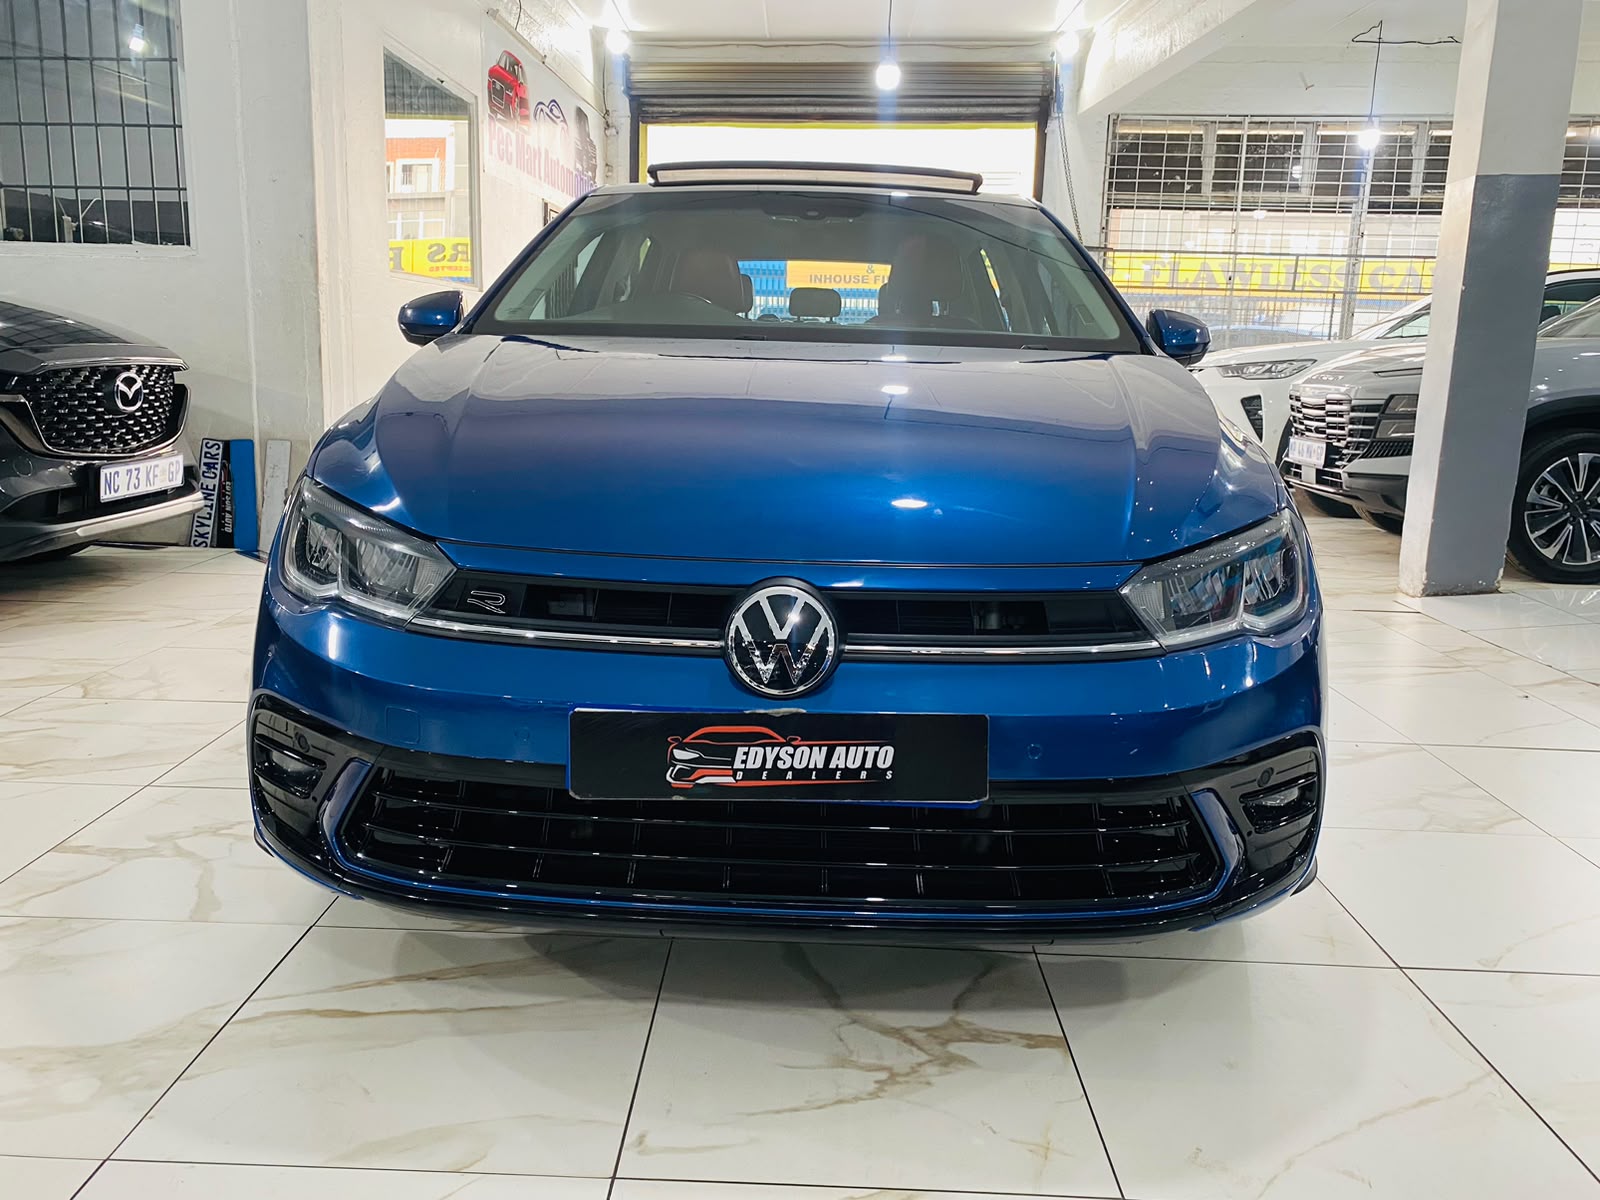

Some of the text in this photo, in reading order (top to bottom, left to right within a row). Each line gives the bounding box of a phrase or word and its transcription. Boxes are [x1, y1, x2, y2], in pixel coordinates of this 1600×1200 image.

[515, 131, 543, 181] Mart
[809, 274, 869, 284] INHOUSE
[1367, 265, 1436, 291] CA
[202, 441, 221, 479] CARS
[104, 460, 182, 496] NC 73 KF GP
[733, 745, 895, 770] EDYSON AUTO
[735, 770, 895, 781] DEALERS
